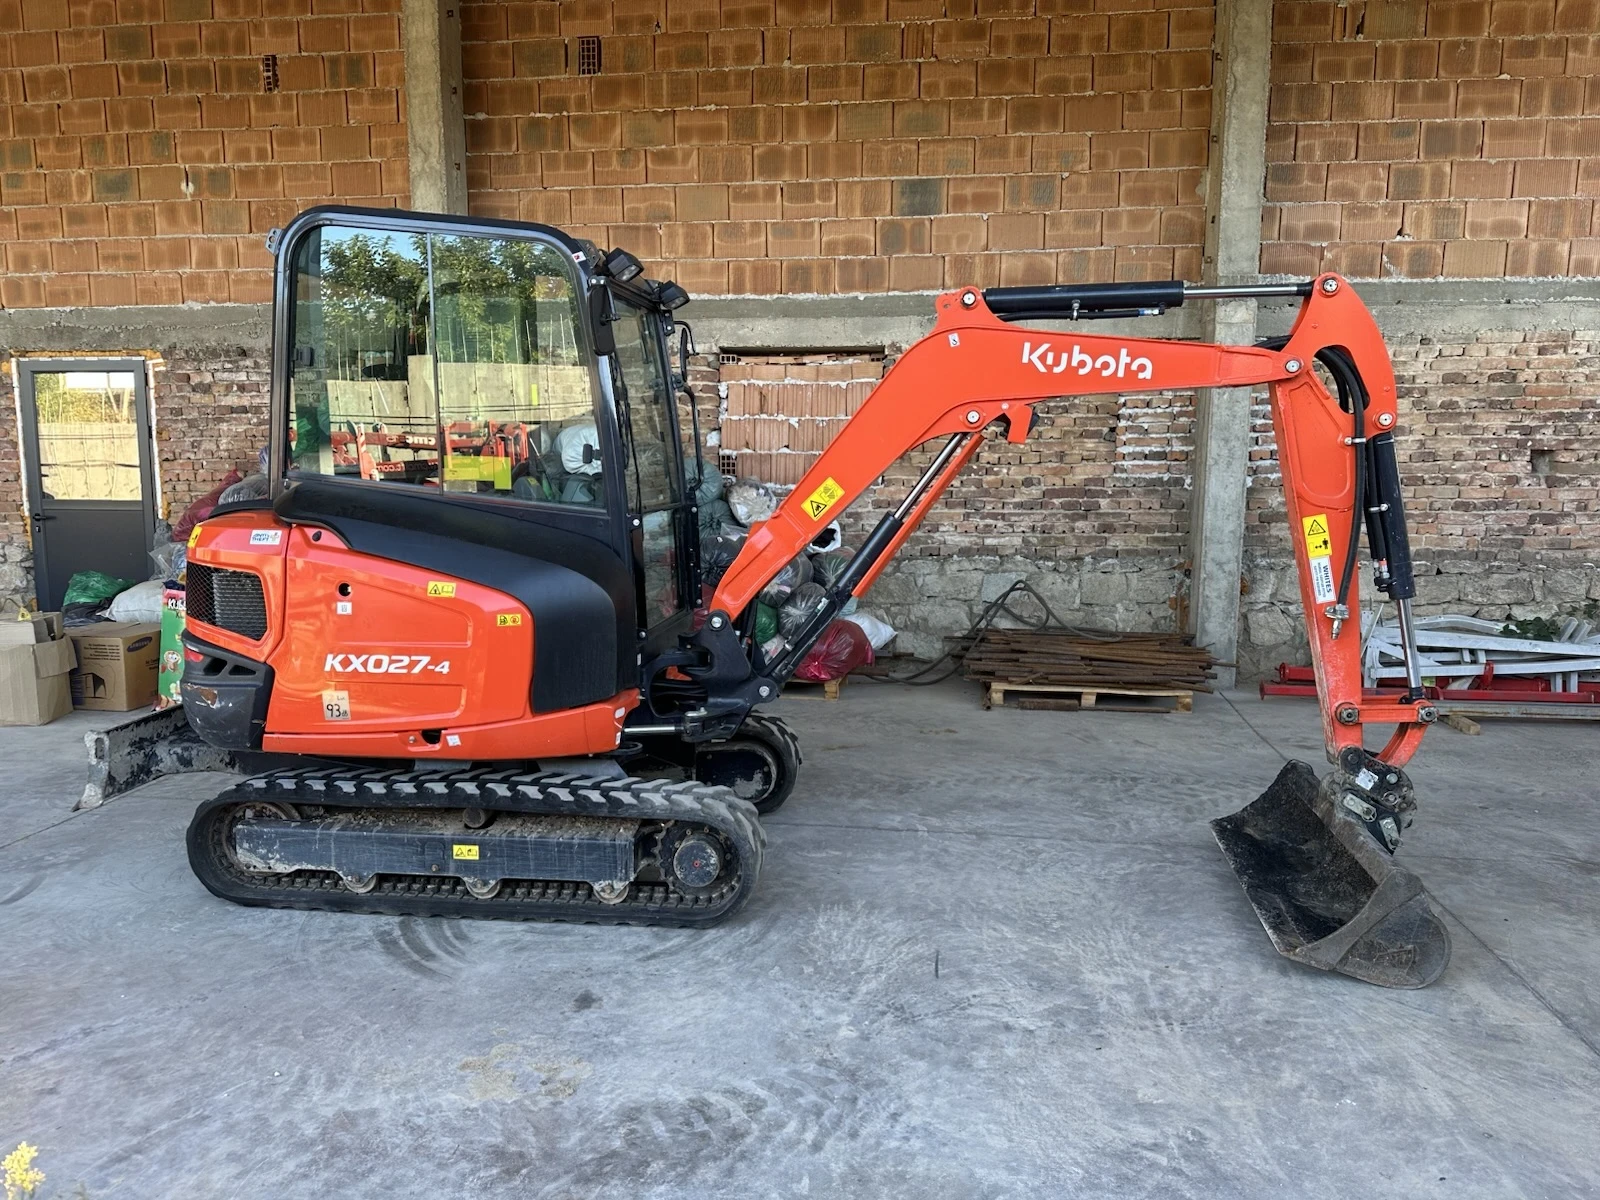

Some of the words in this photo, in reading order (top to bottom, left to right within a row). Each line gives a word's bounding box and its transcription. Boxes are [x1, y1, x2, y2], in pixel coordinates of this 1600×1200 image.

[1021, 341, 1153, 380] Kubota
[1322, 564, 1333, 593] WHITES
[323, 653, 451, 675] KX027-4
[326, 703, 341, 718] 93
